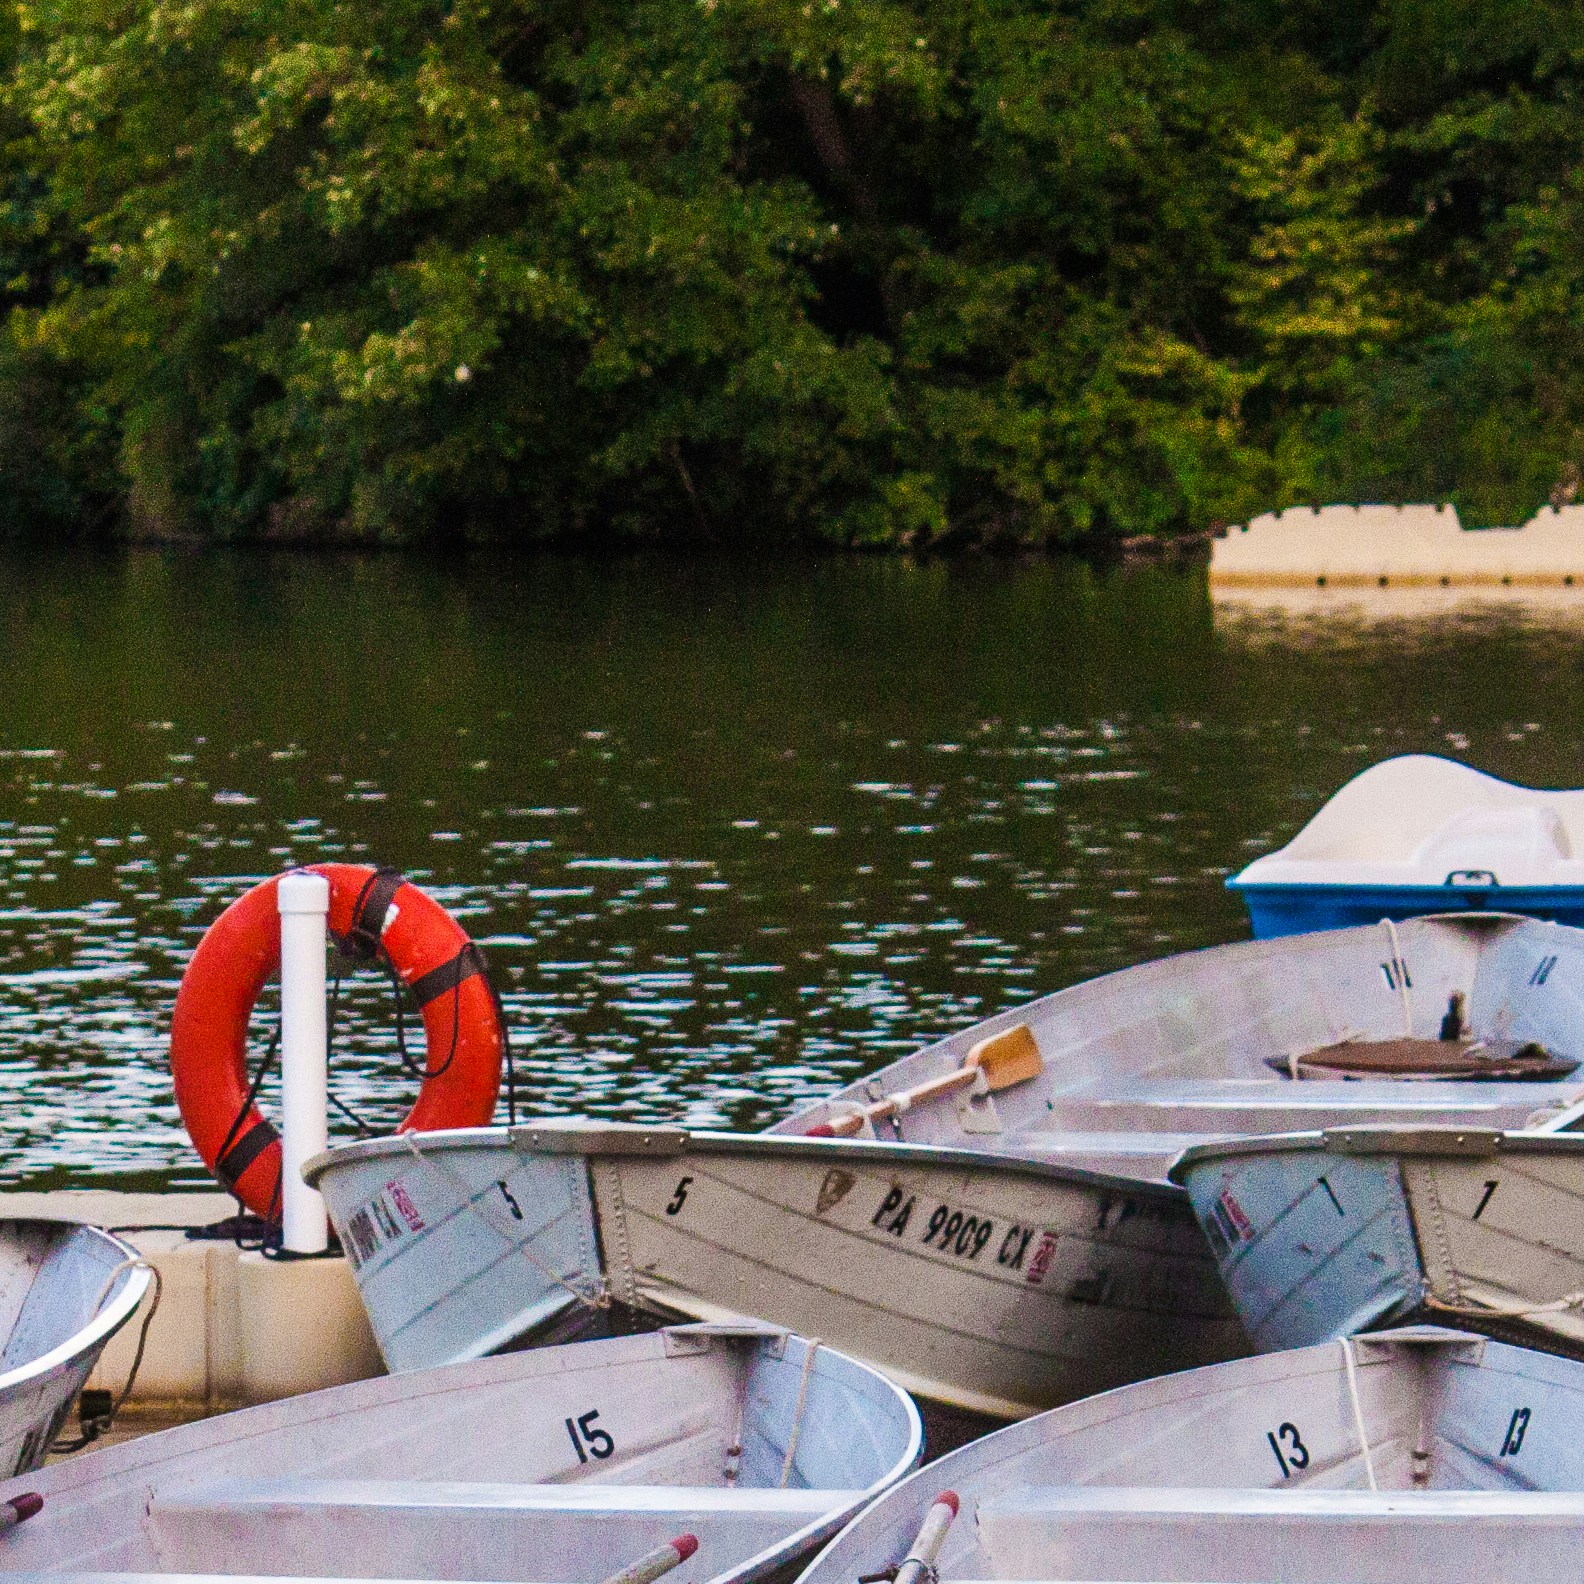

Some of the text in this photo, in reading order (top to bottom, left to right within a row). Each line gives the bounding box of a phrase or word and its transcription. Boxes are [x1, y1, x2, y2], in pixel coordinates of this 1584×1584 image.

[666, 1176, 694, 1216] 5
[1471, 1180, 1499, 1220] 7
[870, 1186, 916, 1238] PA
[997, 1225, 1035, 1269] CX
[565, 1409, 615, 1464] 15
[1267, 1421, 1310, 1479] 13
[1500, 1407, 1532, 1457] 13
